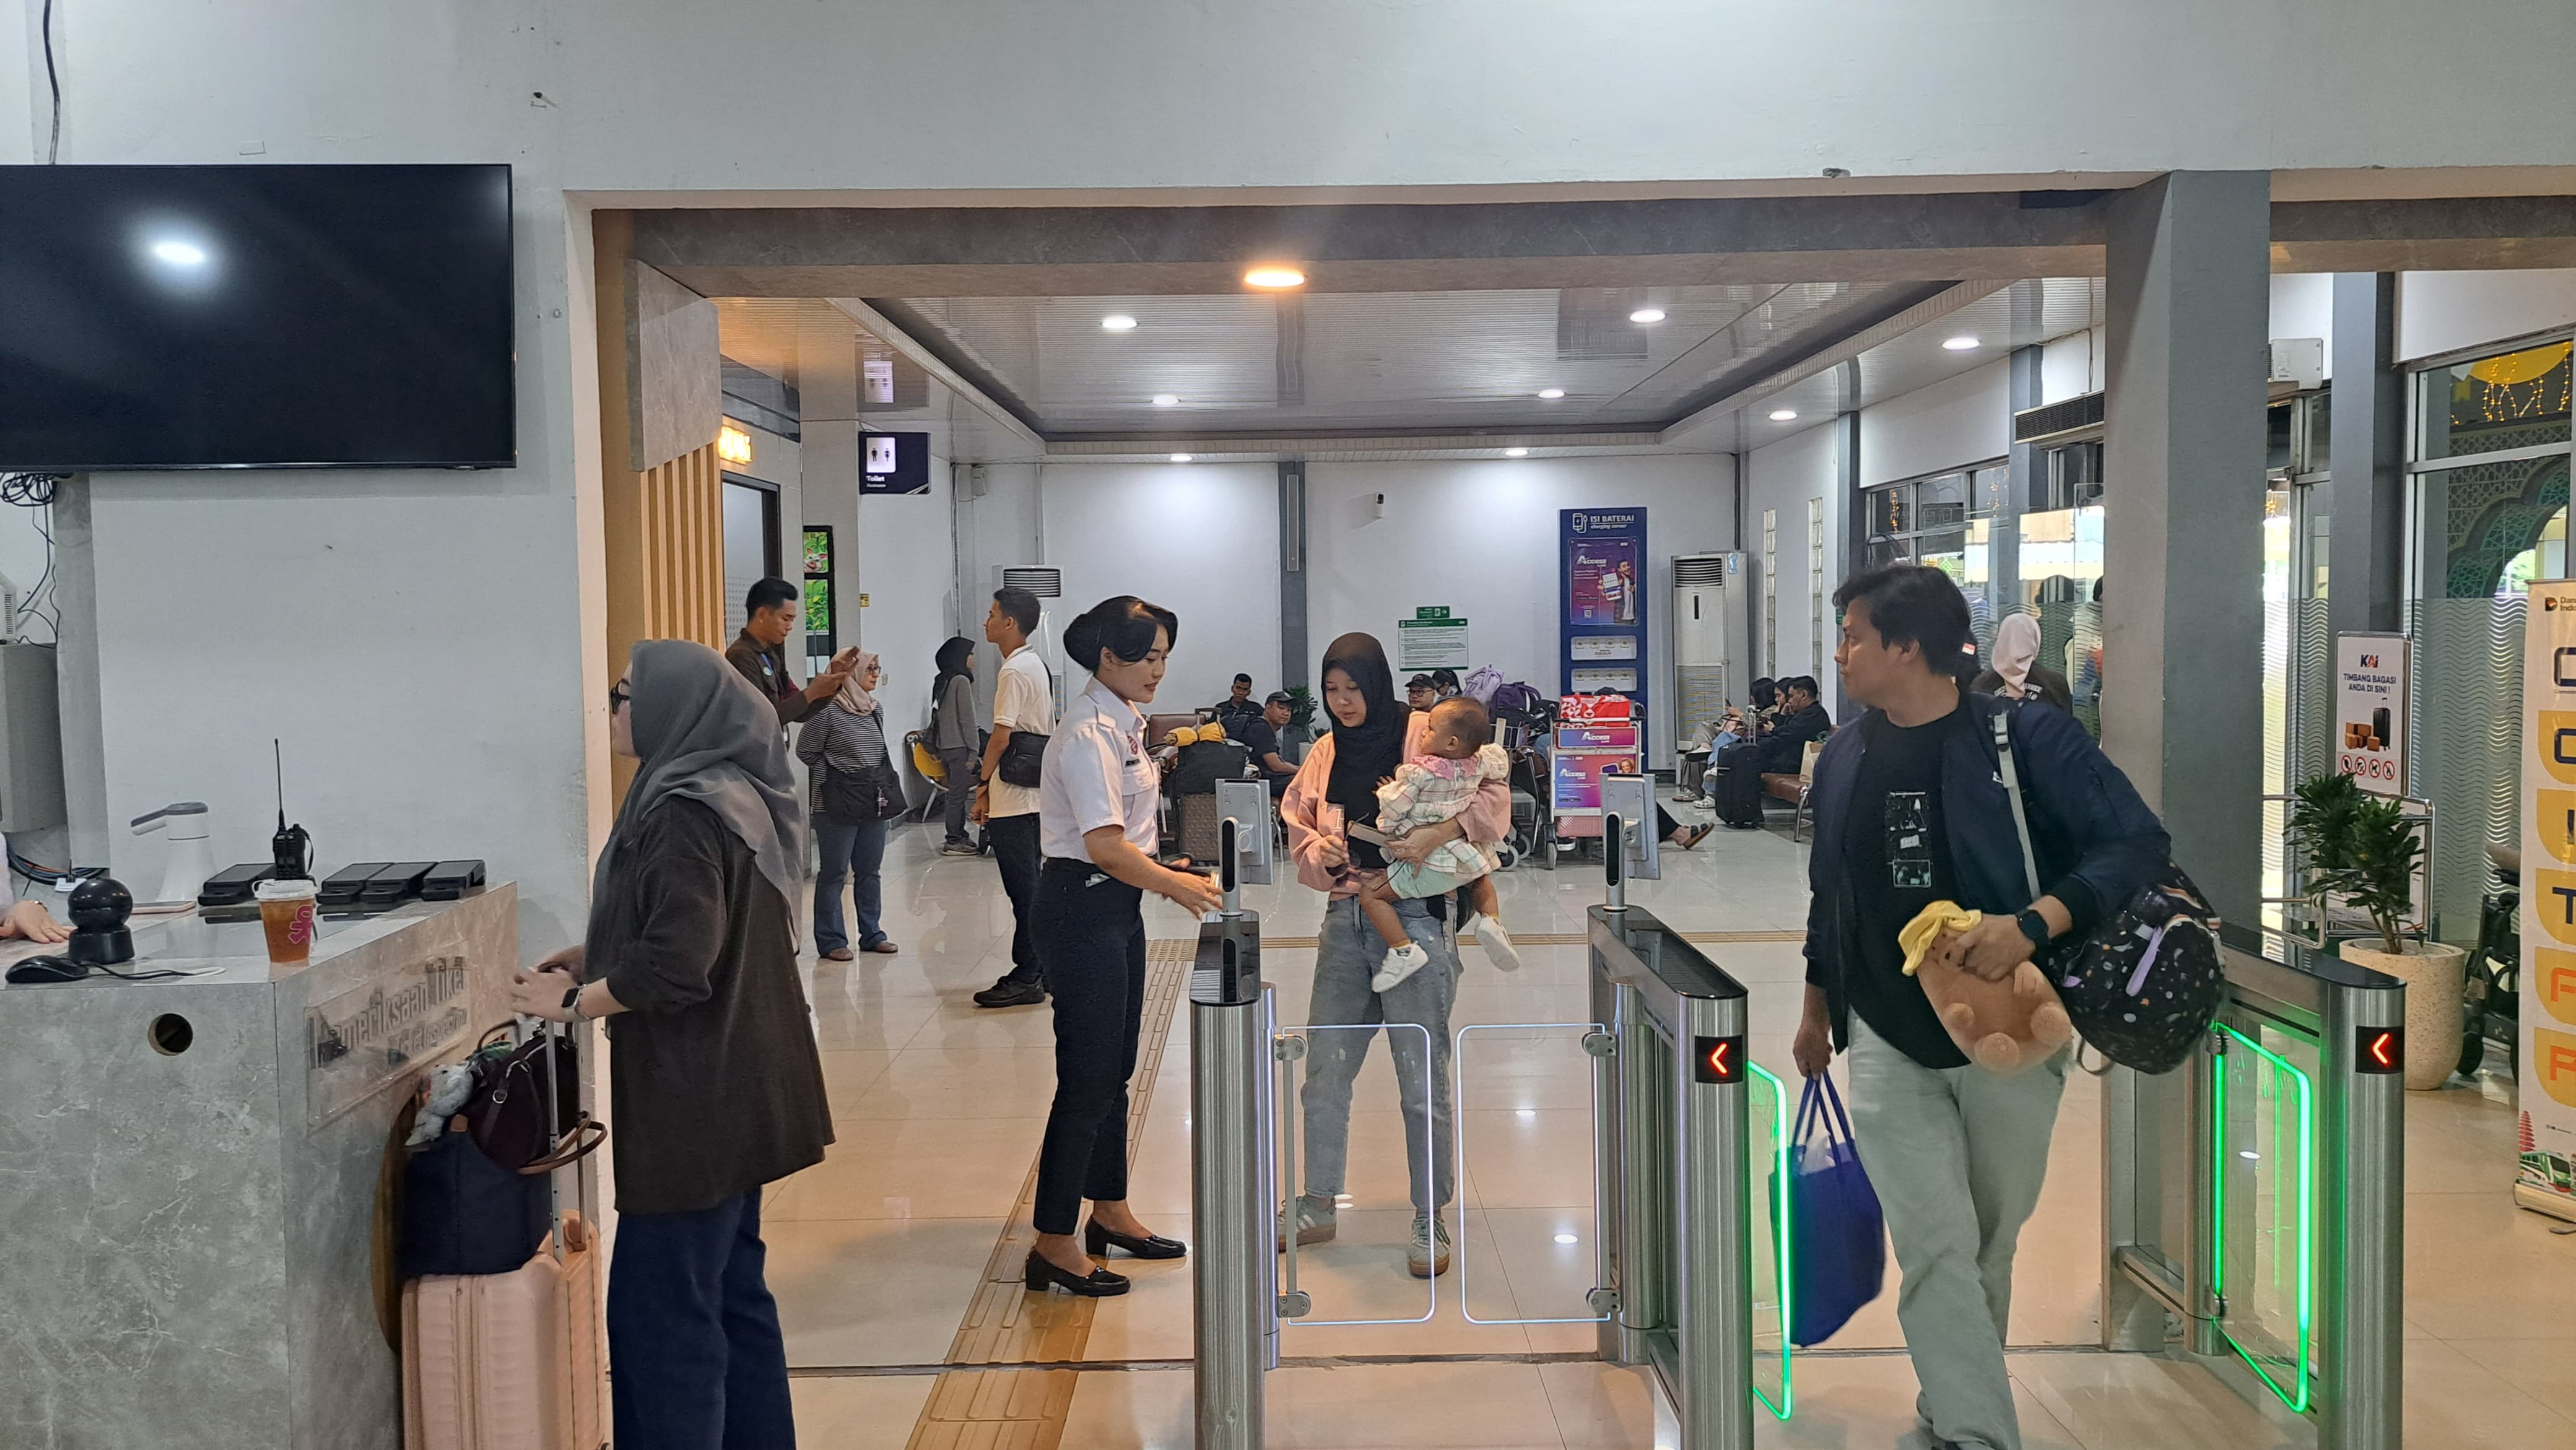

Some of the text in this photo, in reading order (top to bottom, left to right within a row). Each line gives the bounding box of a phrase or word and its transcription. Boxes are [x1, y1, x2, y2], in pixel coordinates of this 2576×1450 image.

[2343, 672, 2396, 684] TIMBANG BAGASI
[2348, 683, 2365, 692] ANDA
[2366, 684, 2374, 692] DI
[2374, 685, 2387, 693] SINI
